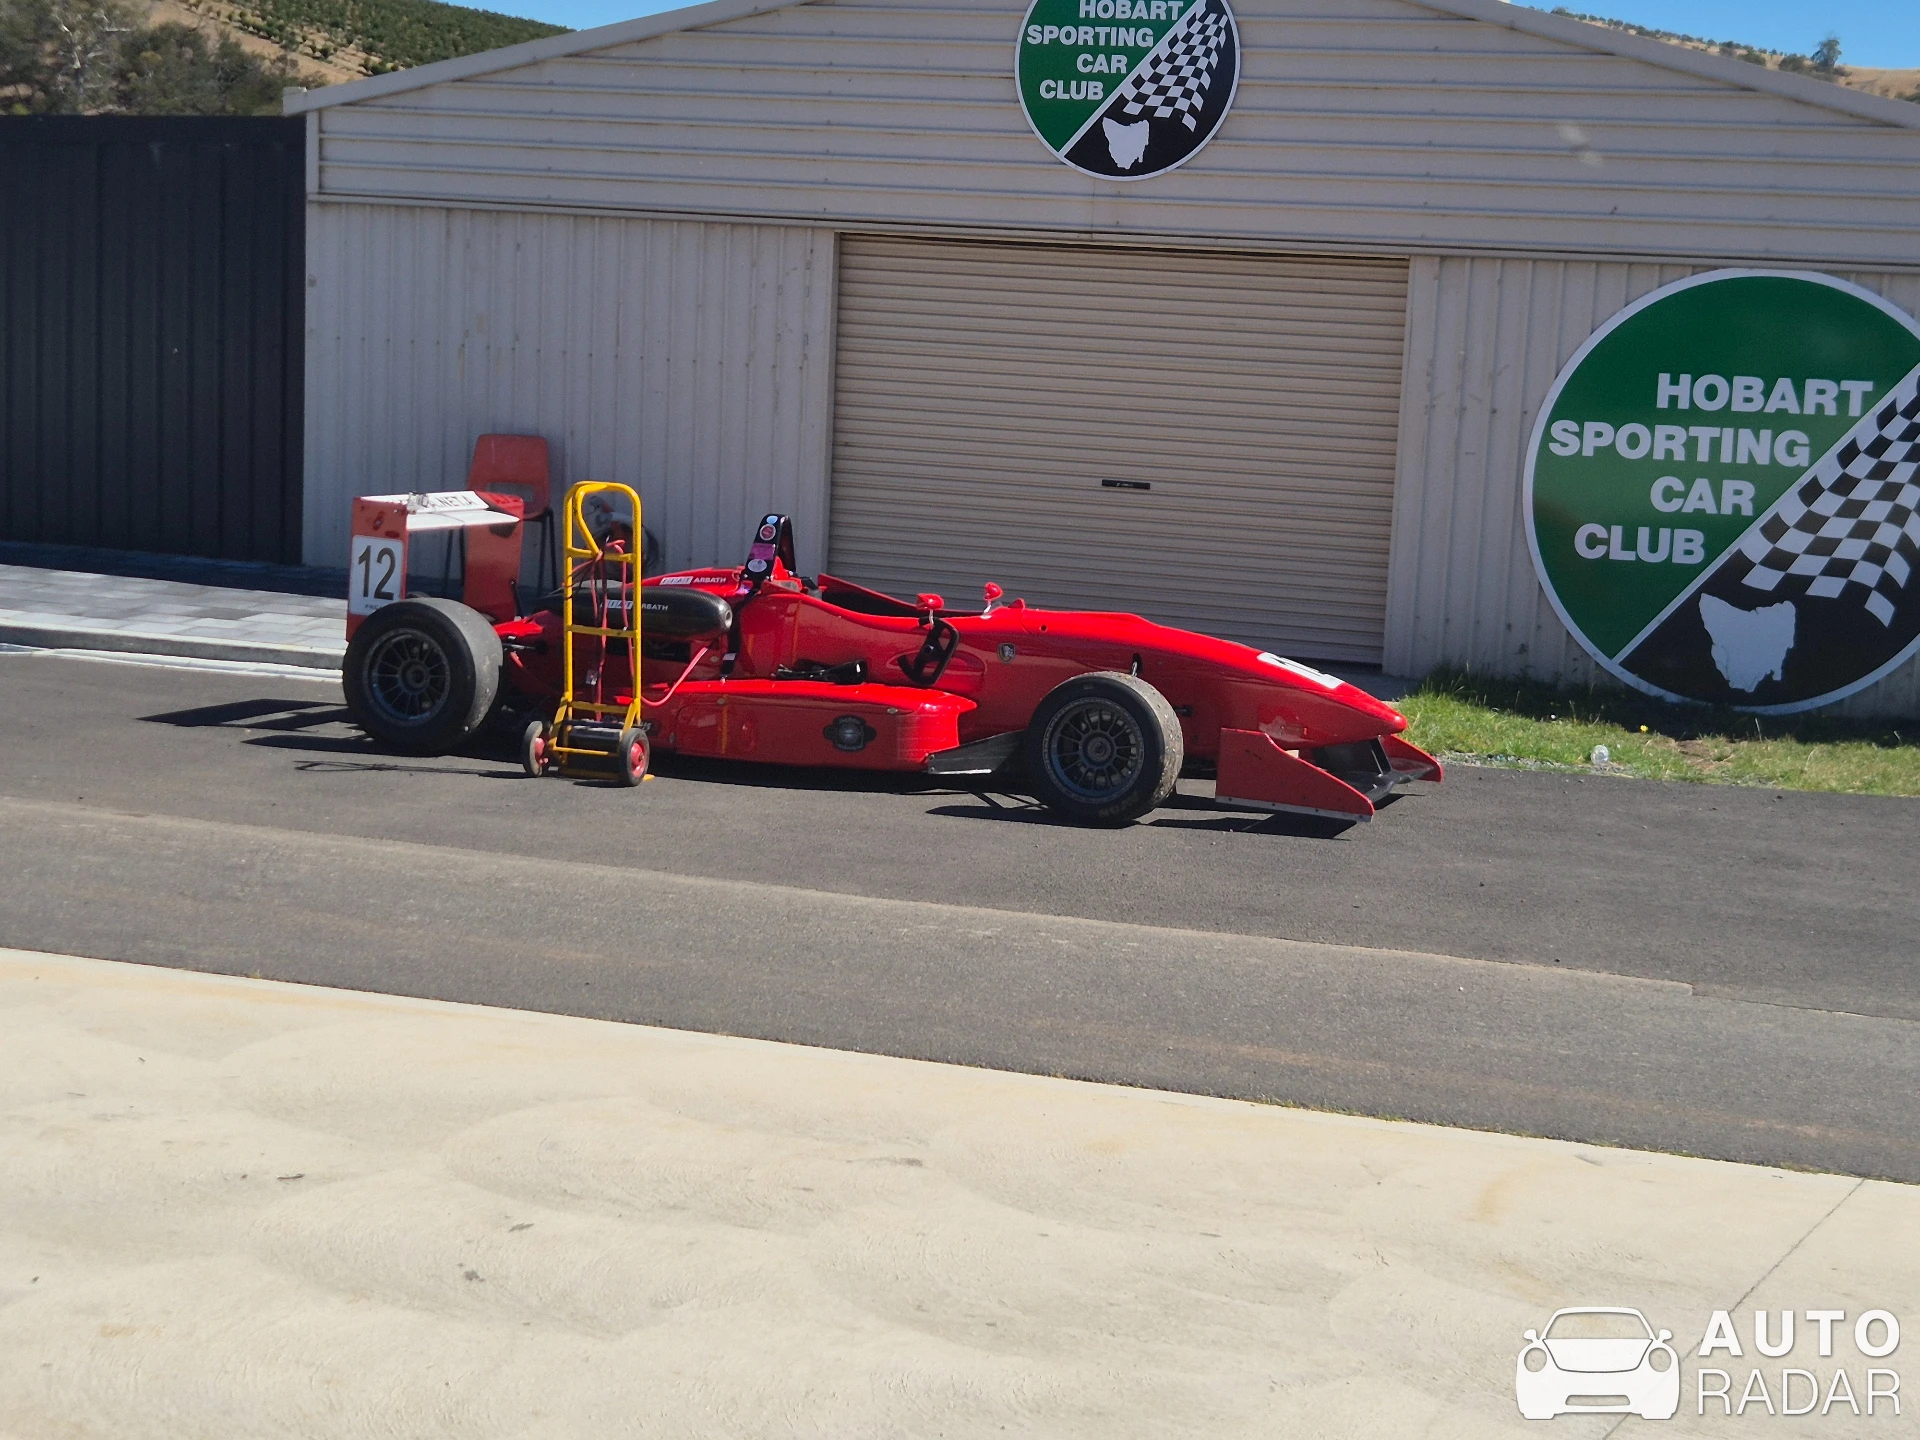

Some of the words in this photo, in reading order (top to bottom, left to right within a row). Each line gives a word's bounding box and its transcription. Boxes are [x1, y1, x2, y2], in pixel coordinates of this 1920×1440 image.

[1079, 0, 1183, 20] HOBART
[1026, 24, 1154, 47] SPORTING
[1076, 53, 1128, 74] CAR
[1039, 79, 1104, 100] CLUB
[1656, 372, 1873, 417] HOBART
[1548, 420, 1810, 467] SPORTING
[1649, 476, 1756, 516] CAR
[1574, 523, 1705, 564] CLUB
[358, 545, 395, 600] 12
[660, 576, 693, 585] FIAT
